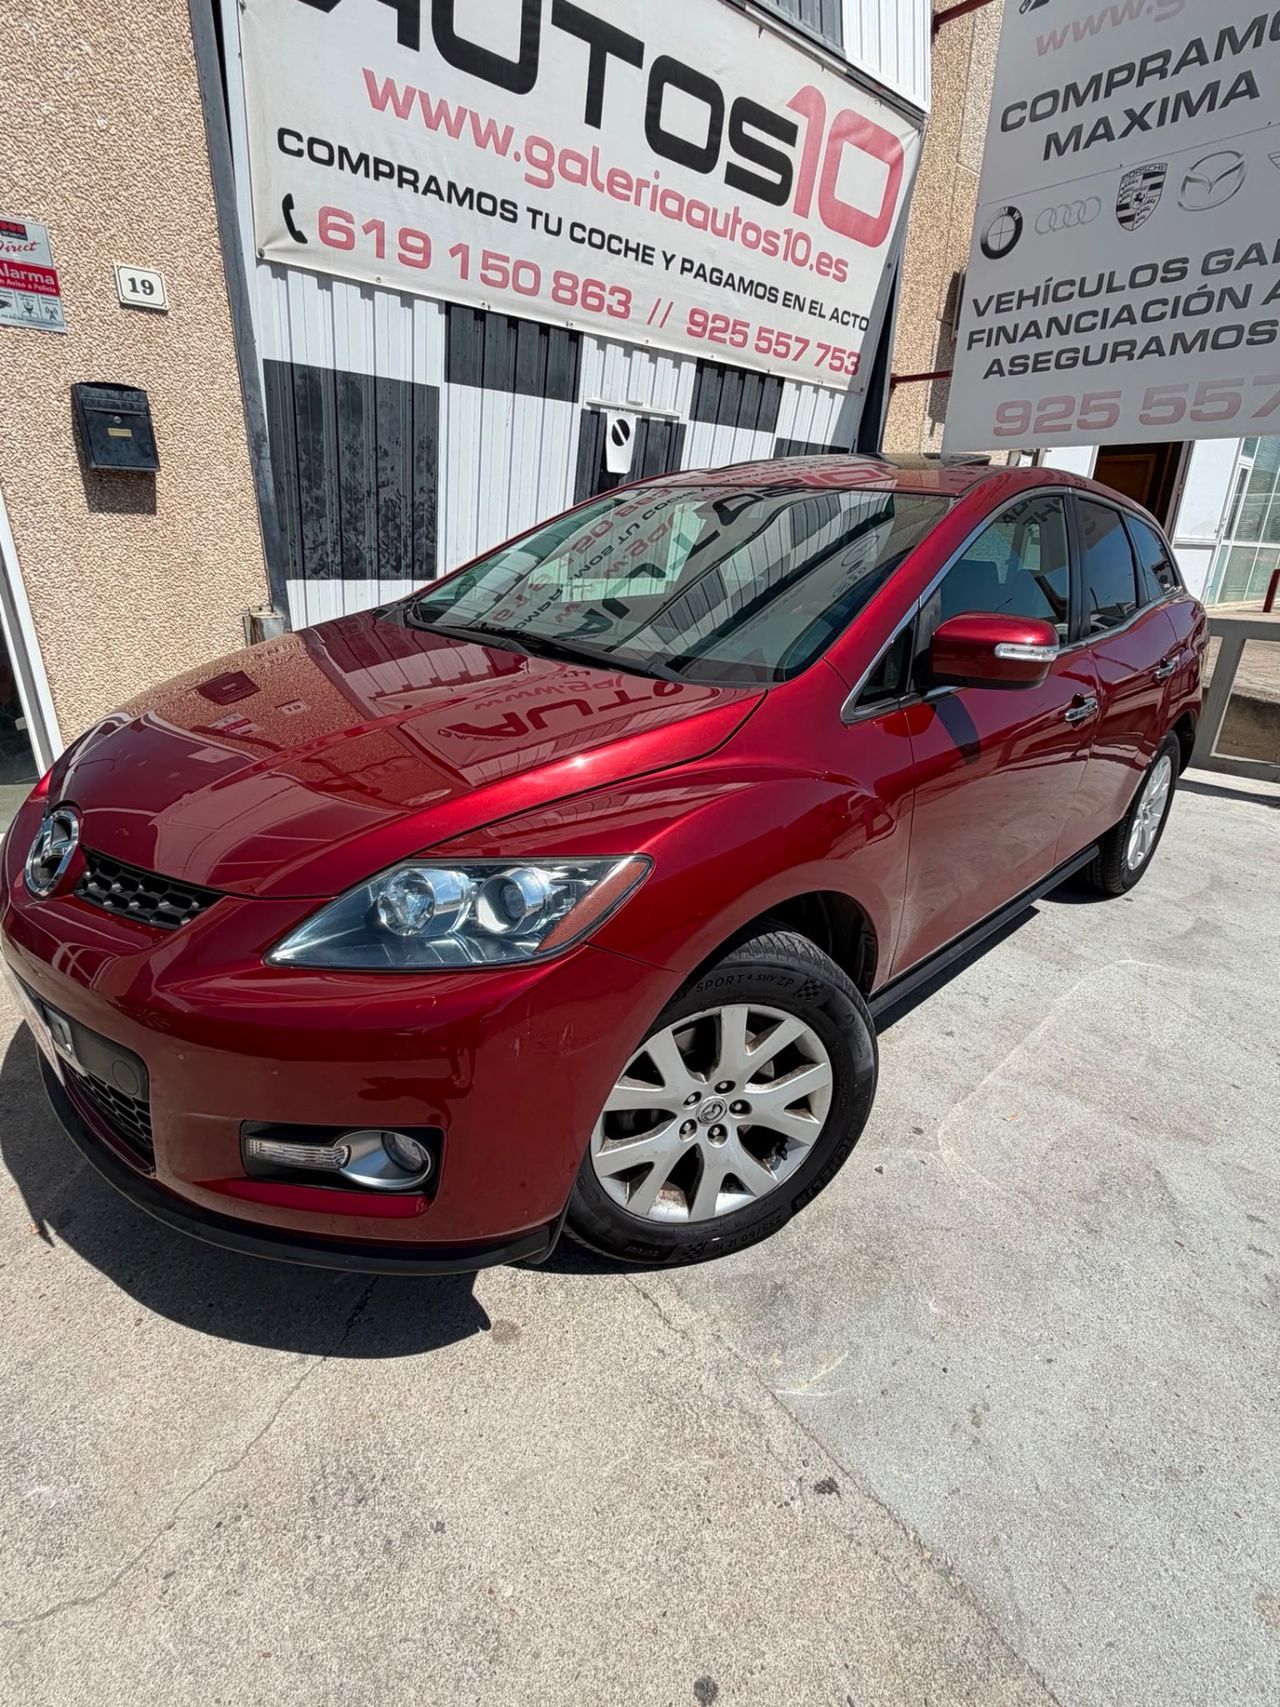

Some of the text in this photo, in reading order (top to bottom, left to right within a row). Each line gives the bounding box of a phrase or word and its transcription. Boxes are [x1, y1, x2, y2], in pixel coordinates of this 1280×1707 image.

[1000, 9, 1280, 132] COMPRAM
[1043, 70, 1260, 161] MAXIMA
[362, 67, 849, 284] www.galeriaautos10.es
[277, 127, 870, 332] COMPRAMOS TU COCHE Y PAGAMOS EN EL ACTO
[128, 277, 155, 296] 19
[318, 206, 432, 269] 619
[448, 243, 541, 297] 150
[551, 270, 632, 321] 863
[686, 308, 750, 348] 925
[754, 326, 810, 362] 557
[814, 344, 861, 377] 753
[966, 283, 1253, 350] FINANCIACIÓN
[972, 238, 1280, 317] VEHÍCULOS GA
[982, 319, 1279, 379] ASEGURAMOS
[992, 390, 1122, 437] 925
[696, 974, 745, 993] SPORT
